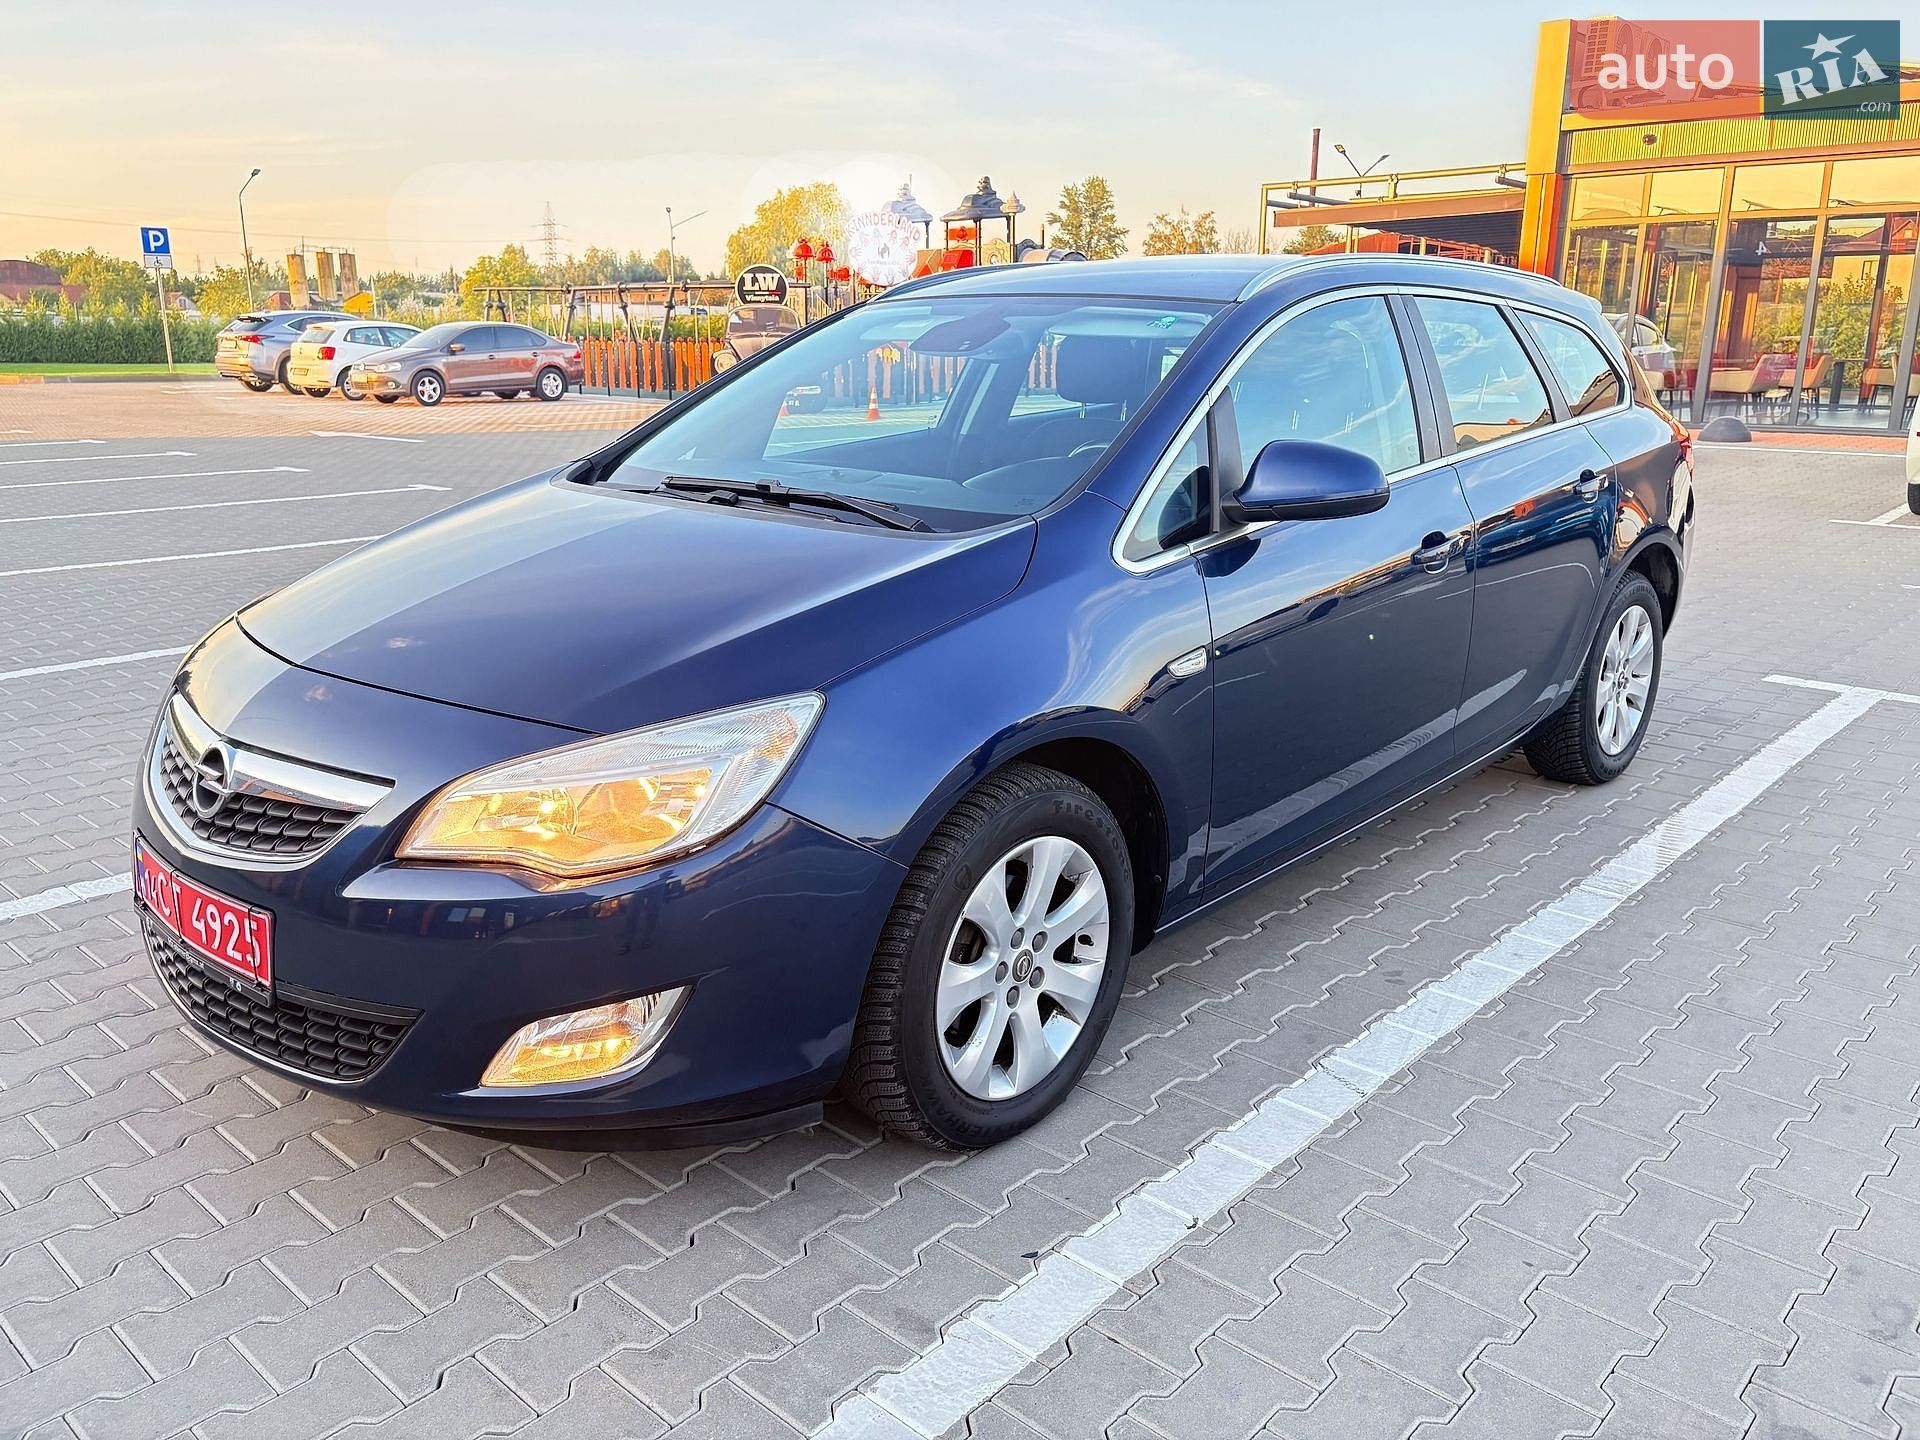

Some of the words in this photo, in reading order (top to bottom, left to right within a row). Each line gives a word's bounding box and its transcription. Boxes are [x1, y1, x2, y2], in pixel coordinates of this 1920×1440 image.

[148, 229, 165, 252] P
[742, 272, 781, 291] LW
[191, 897, 261, 968] 4925
